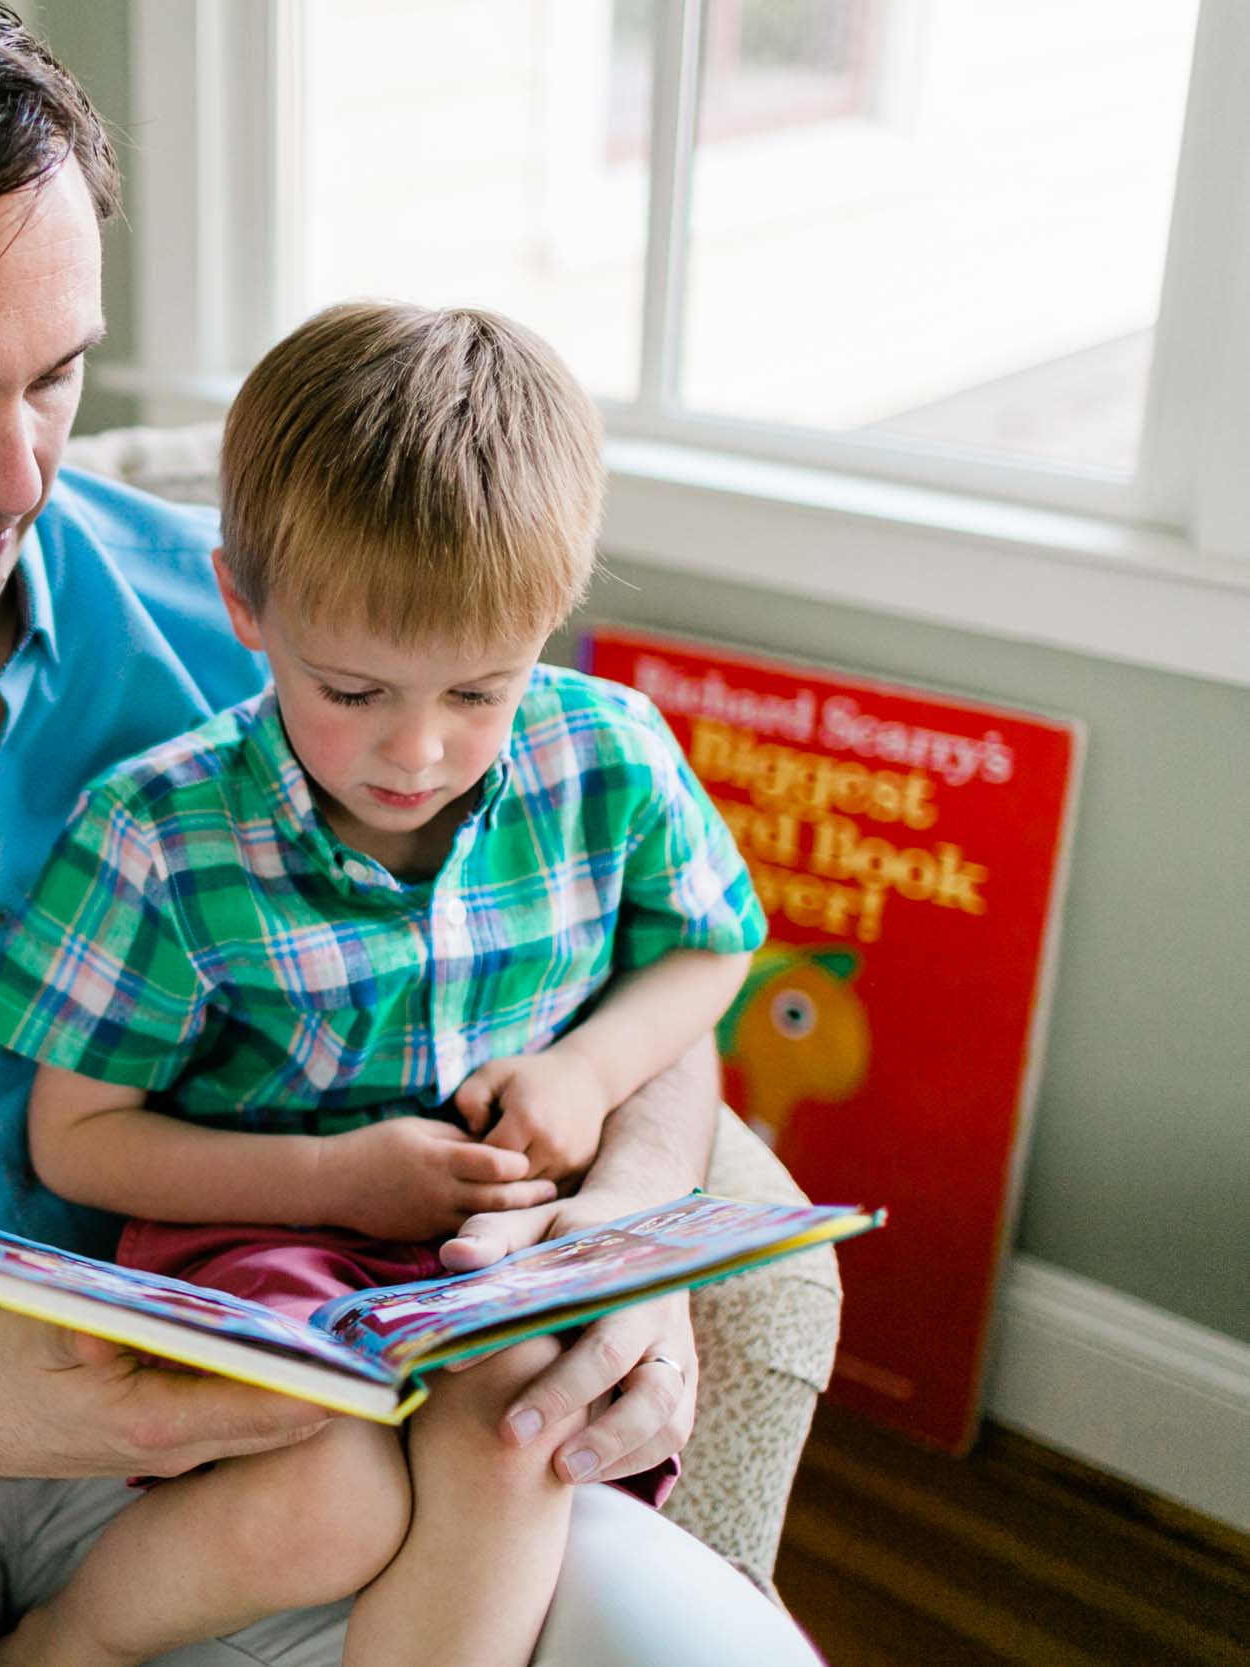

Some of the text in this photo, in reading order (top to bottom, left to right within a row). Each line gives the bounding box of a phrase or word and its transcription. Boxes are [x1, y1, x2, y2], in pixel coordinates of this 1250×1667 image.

[634, 656, 1014, 786] Richard Scarry's
[691, 717, 938, 829] Biggest
[811, 812, 989, 914] Book
